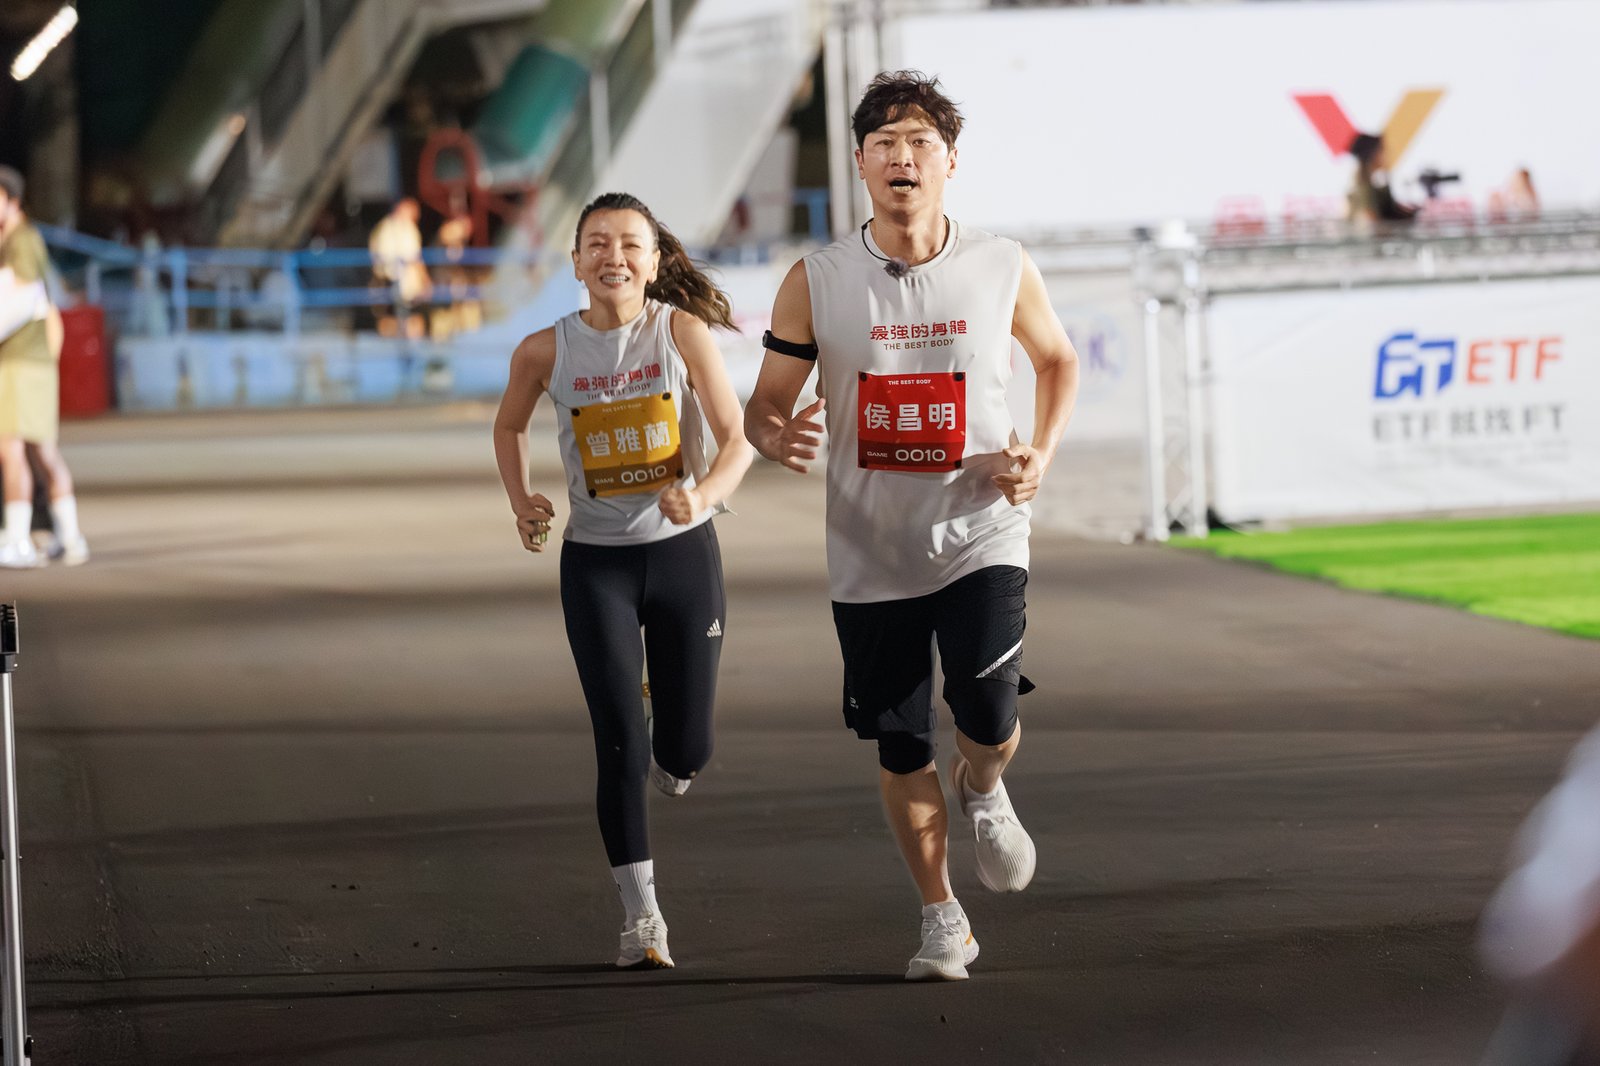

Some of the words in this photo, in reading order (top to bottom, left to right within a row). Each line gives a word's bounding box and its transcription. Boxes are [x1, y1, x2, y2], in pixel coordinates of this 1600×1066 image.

[870, 320, 967, 341] 最強的身體
[884, 343, 901, 351] THE
[904, 341, 928, 350] BEST
[930, 338, 955, 347] BODY
[1466, 336, 1564, 384] ETF
[628, 382, 651, 393] BODY
[863, 402, 956, 432] 侯昌明
[585, 421, 671, 457] 曾雅蘭
[895, 449, 946, 462] 0010
[621, 465, 667, 484] 0010
